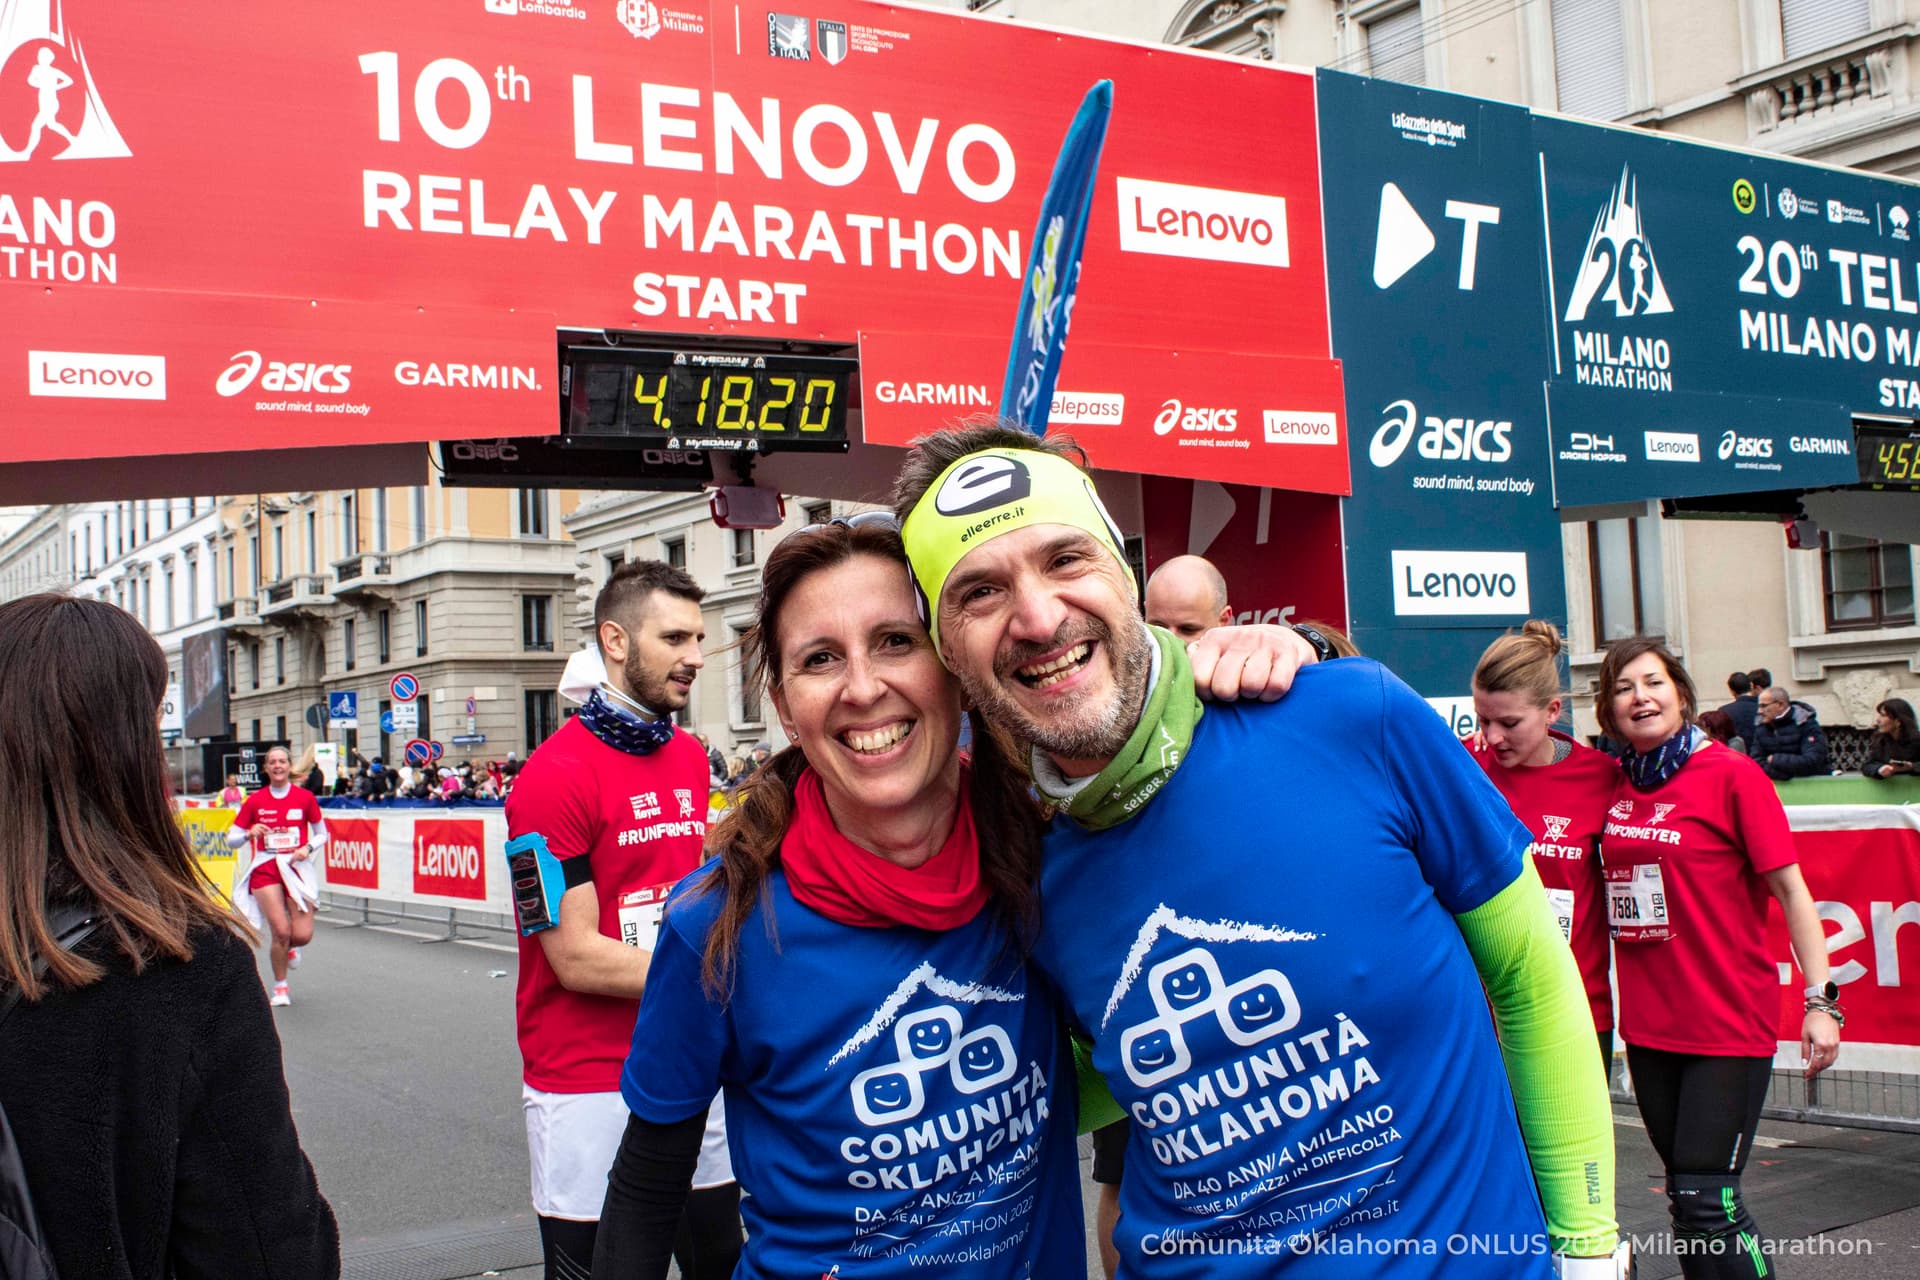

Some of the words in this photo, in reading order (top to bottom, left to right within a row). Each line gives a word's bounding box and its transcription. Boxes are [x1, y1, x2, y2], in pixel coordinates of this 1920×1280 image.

[519, 1, 587, 20] Lombardia
[662, 18, 704, 34] Milano
[820, 22, 845, 32] ITALIA
[572, 74, 1016, 203] LENOVO
[363, 170, 617, 245] RELAY
[643, 195, 1022, 279] MARATHON
[1135, 196, 1273, 246] Lenovo
[1445, 200, 1500, 291] T
[0, 246, 117, 284] THON
[1829, 248, 1920, 315] TEL
[633, 273, 807, 324] START
[1573, 330, 1671, 370] MILANO
[1740, 309, 1876, 363] MILANO
[43, 361, 153, 387] Lenovo
[1576, 363, 1673, 392] MARATHON
[255, 401, 287, 412] sound
[287, 401, 312, 414] mind,
[315, 403, 345, 414] sound
[346, 404, 371, 417] body
[1049, 395, 1120, 419] elepass
[1235, 440, 1250, 450] body
[1271, 418, 1330, 436] Lenovo
[1592, 453, 1627, 463] HOPPER
[1650, 438, 1694, 454] Lenovo
[1413, 474, 1446, 489] sound
[1447, 475, 1475, 492] mind,
[1476, 477, 1508, 492] sound
[1509, 478, 1535, 496] body
[960, 506, 1025, 543] elleerre.it
[1405, 565, 1516, 598] Lenovo
[237, 774, 261, 784] WALL
[239, 763, 258, 774] LED
[326, 837, 375, 872] Lenovo
[417, 835, 480, 880] Lenovo
[1612, 896, 1640, 920] 758A
[1776, 900, 1920, 988] en
[1131, 1012, 1371, 1130] COMUNITÀ
[841, 1060, 1047, 1164] COMUNITÀ
[1152, 1056, 1381, 1166] OKLAHOMA
[848, 1097, 1050, 1191] OKLAHOMA
[1173, 1181, 1196, 1201] DA
[1197, 1177, 1223, 1196] 40
[1297, 1104, 1394, 1158] MILANO
[1225, 1197, 1239, 1211] AI
[1292, 1166, 1309, 1179] IN
[1313, 1126, 1402, 1170] DIFFICOLTÀ
[854, 1206, 887, 1223] DA
[1237, 1192, 1352, 1237] MARATHON
